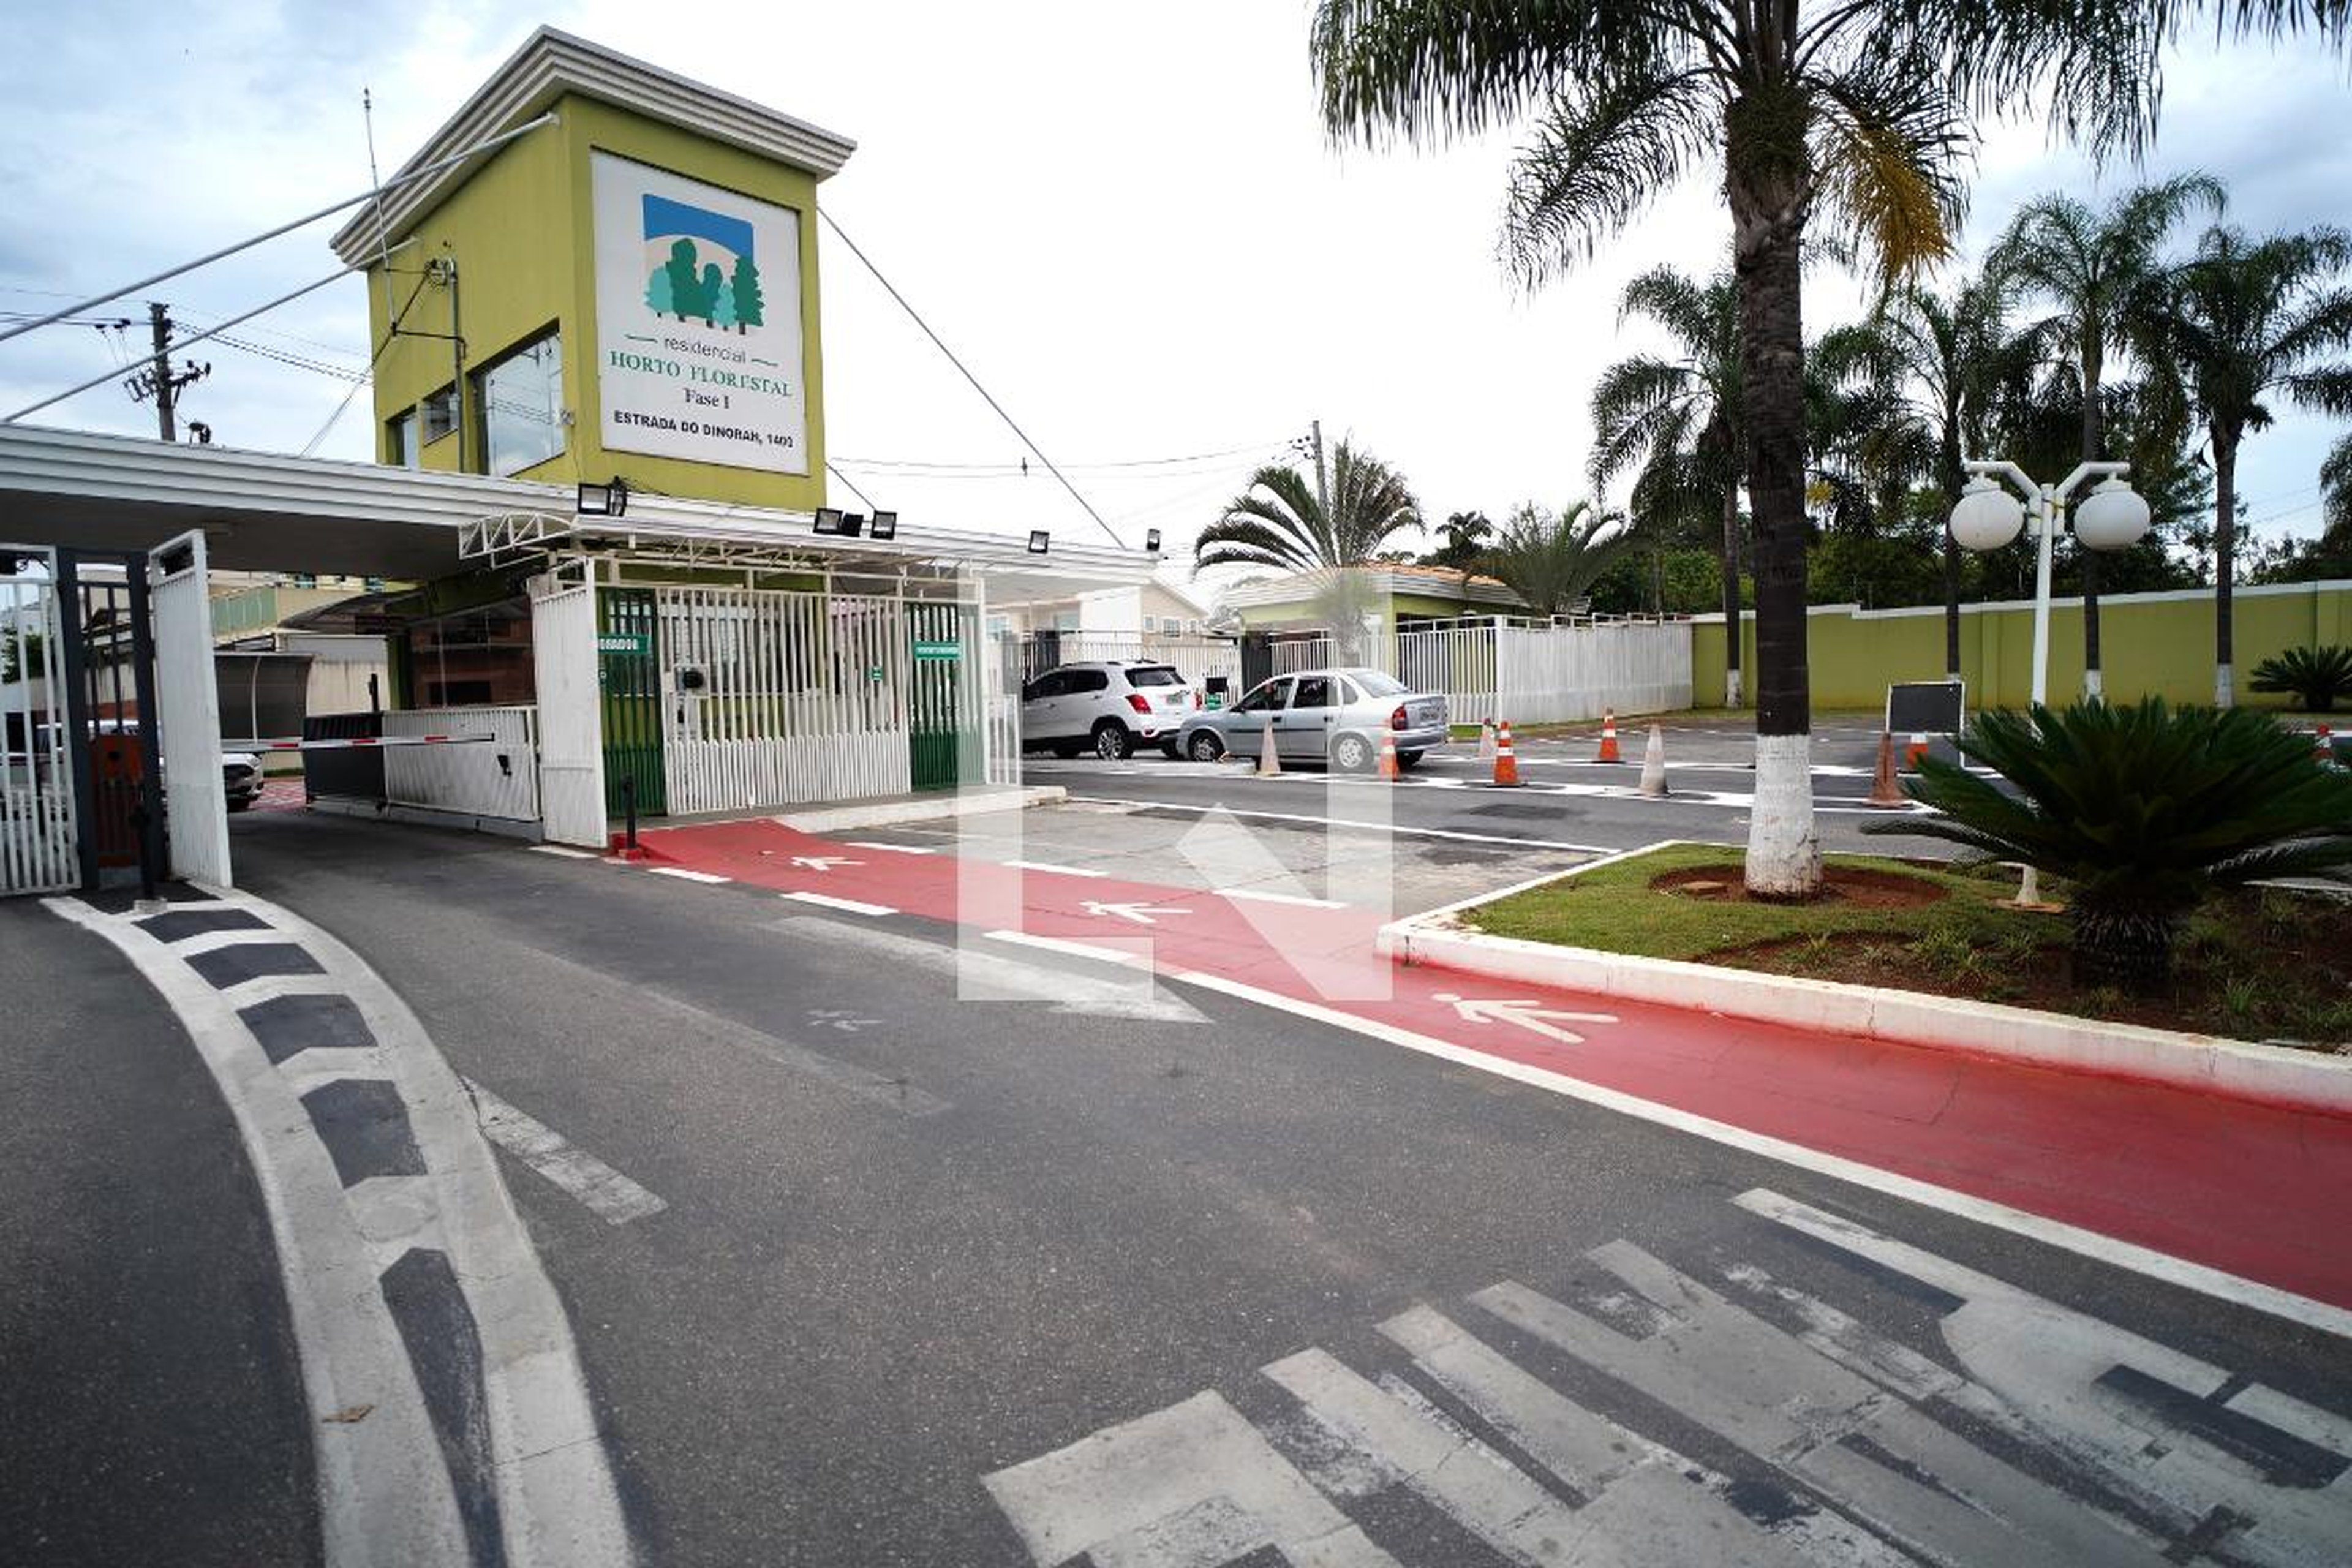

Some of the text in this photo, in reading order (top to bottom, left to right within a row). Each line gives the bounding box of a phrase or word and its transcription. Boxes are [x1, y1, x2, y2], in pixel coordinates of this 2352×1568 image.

[610, 351, 793, 396] HORTO FLORESTAL
[683, 388, 719, 407] Fase
[614, 410, 677, 431] ESTRADA
[681, 421, 699, 434] DO
[703, 424, 763, 445] DINORAH,
